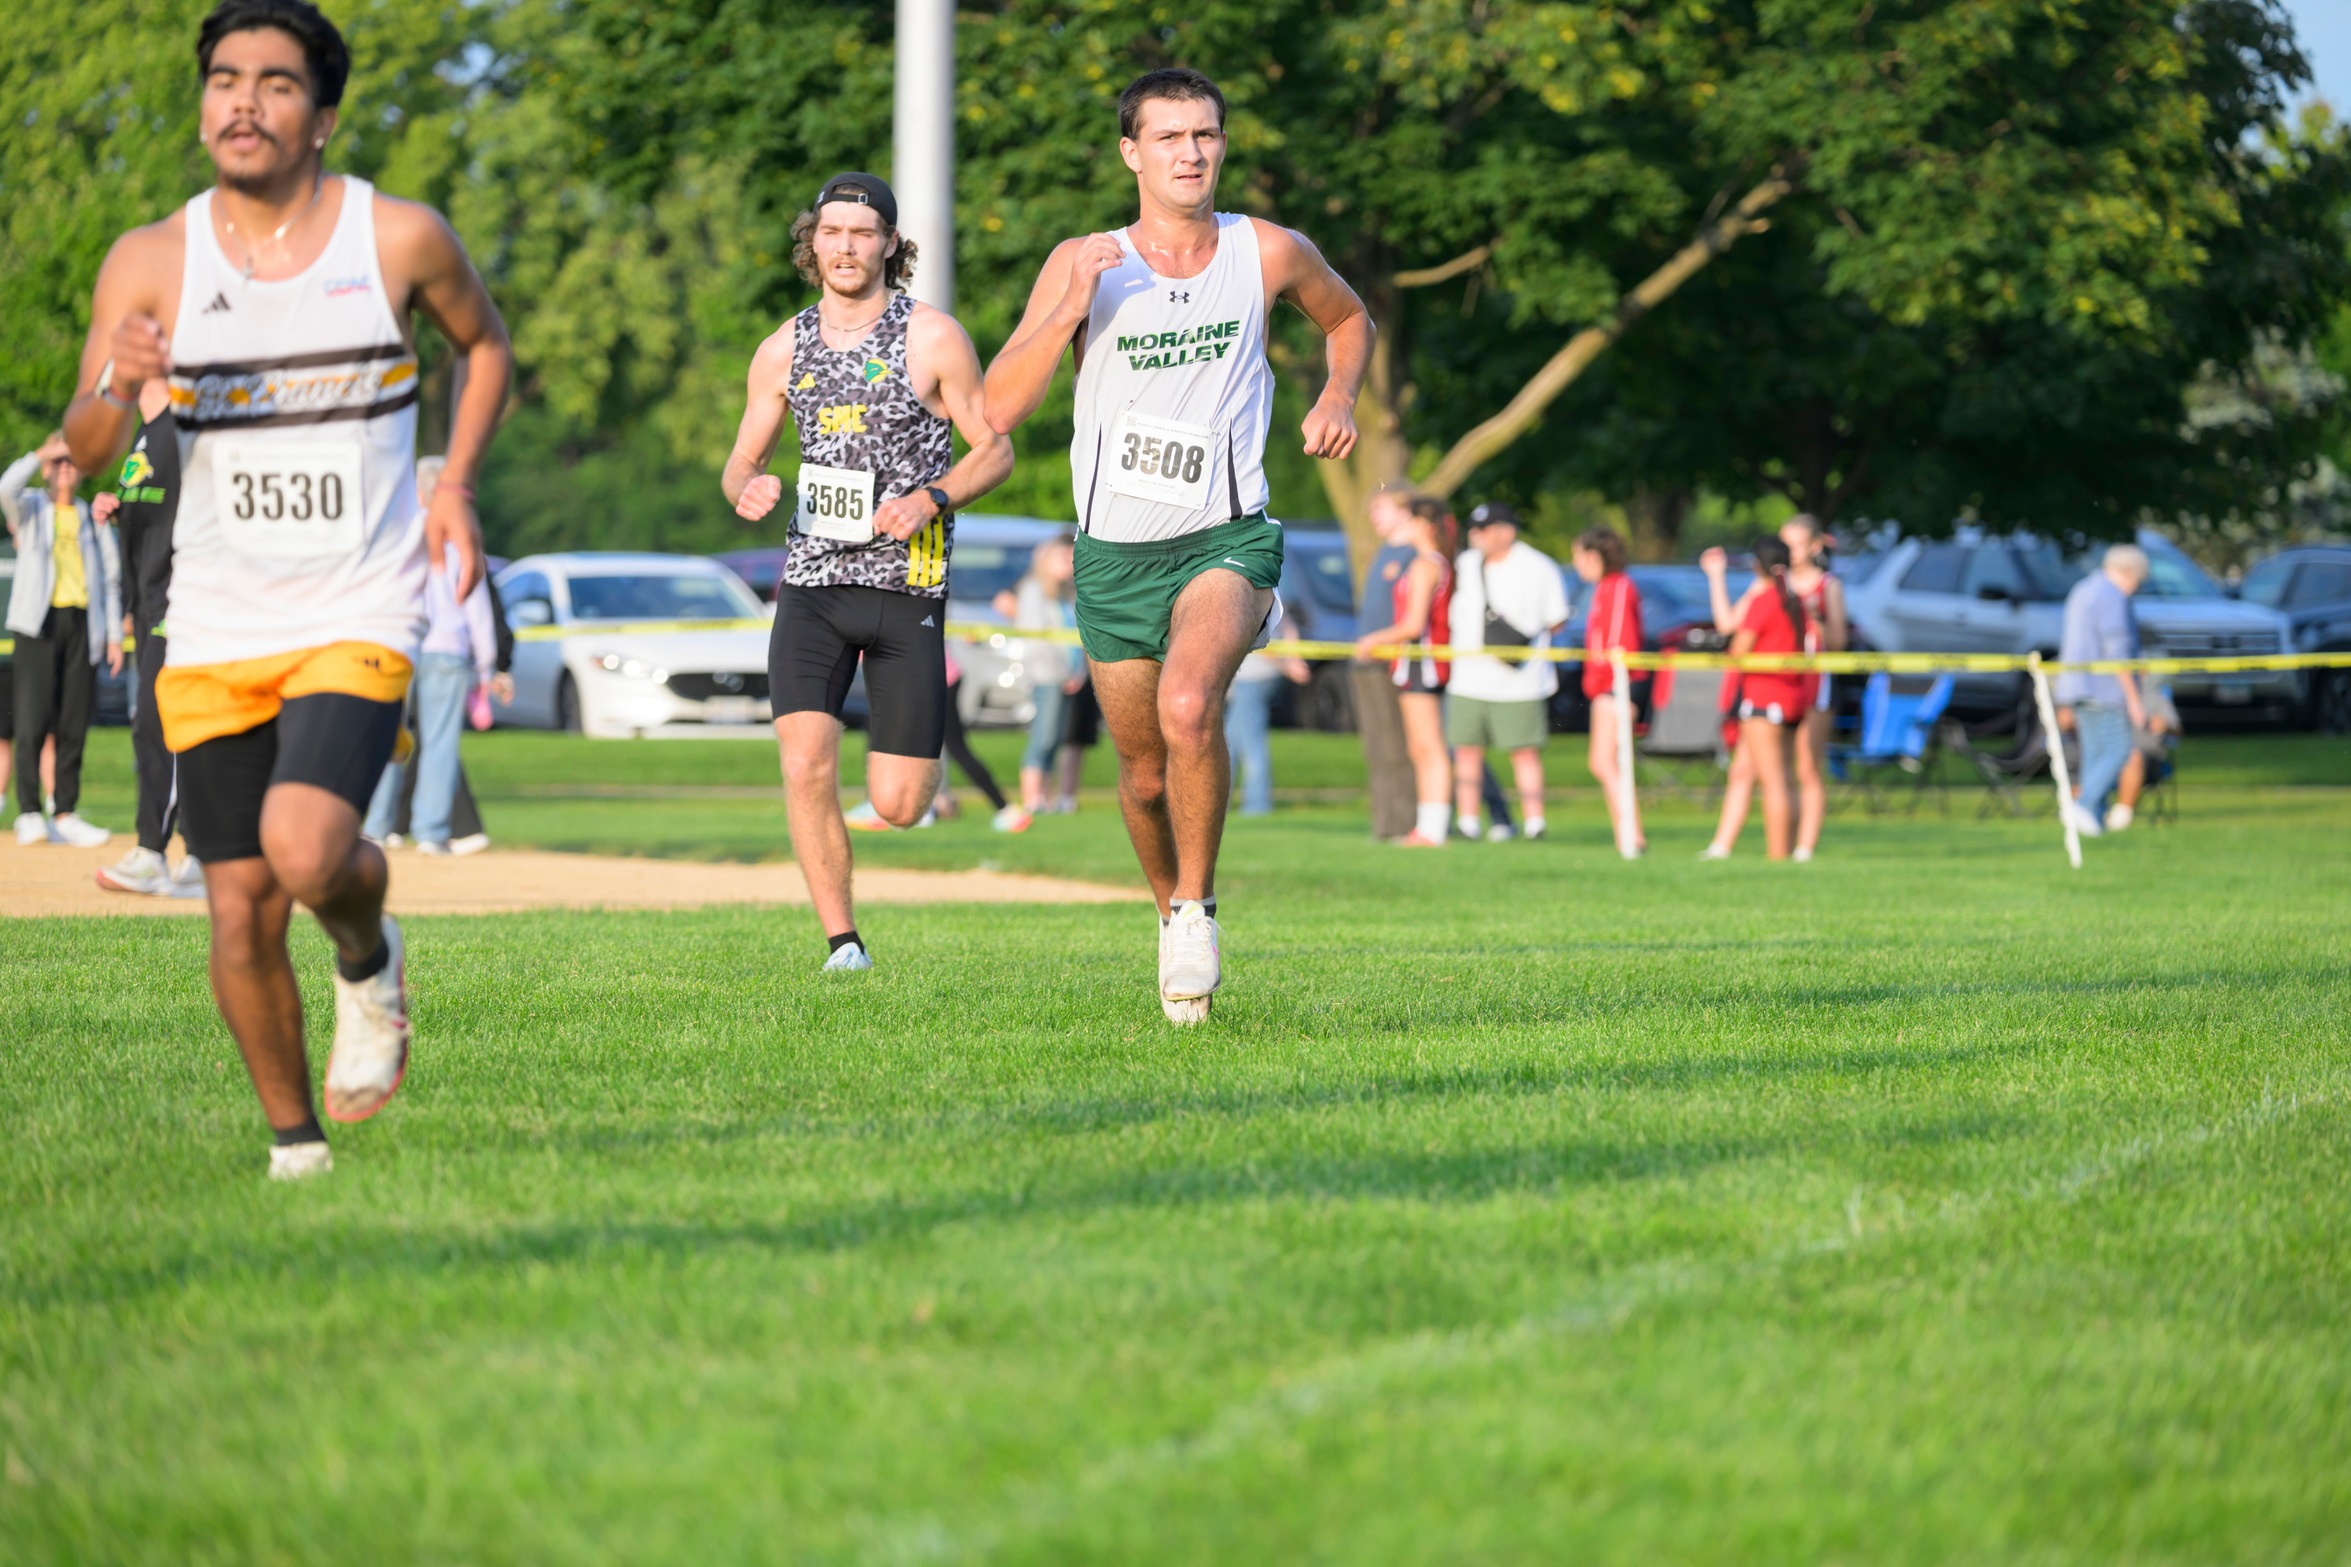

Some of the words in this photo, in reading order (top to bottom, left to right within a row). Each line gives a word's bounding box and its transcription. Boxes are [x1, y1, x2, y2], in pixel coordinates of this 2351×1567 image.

[1117, 320, 1240, 352] MORAINE
[1128, 342, 1231, 371] VALLEY
[1121, 432, 1205, 484] 3508
[232, 472, 343, 520] 3530
[806, 482, 863, 520] 3585
